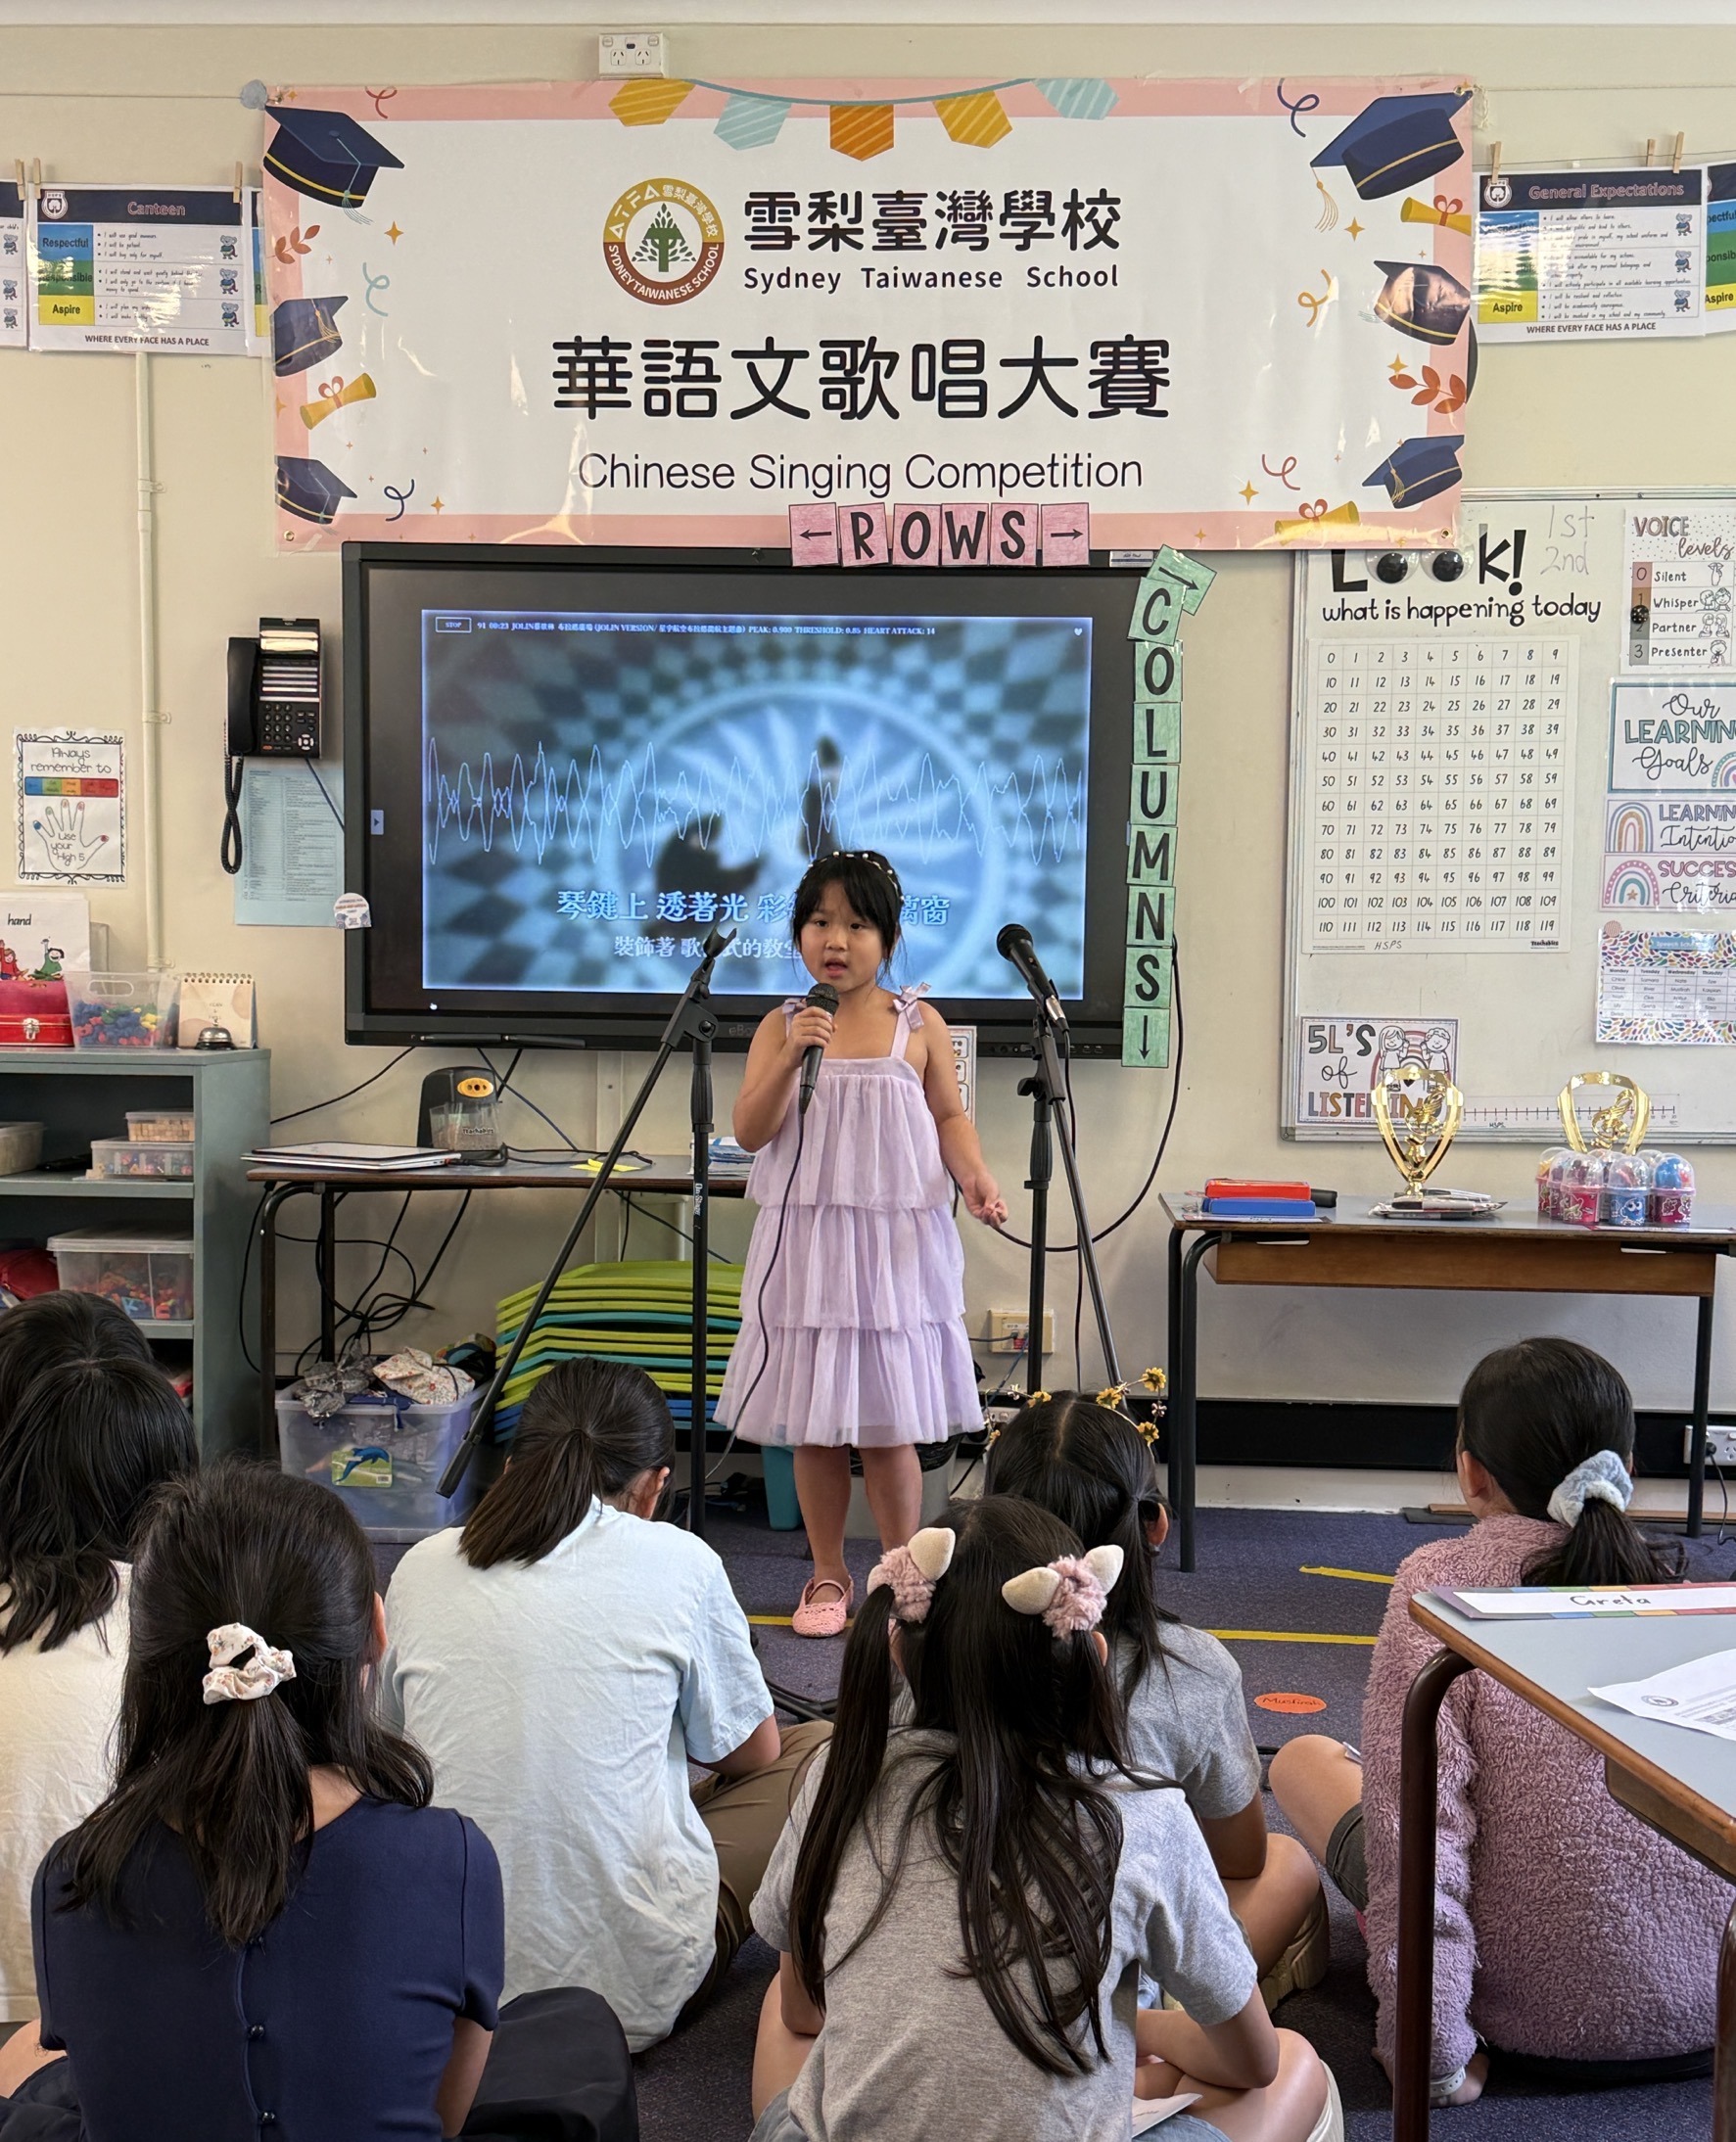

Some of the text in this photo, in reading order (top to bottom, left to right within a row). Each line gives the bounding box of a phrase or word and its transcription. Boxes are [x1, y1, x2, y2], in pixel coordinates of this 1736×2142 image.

[1528, 181, 1684, 201] General Expectations
[127, 201, 186, 216] Canteen
[662, 184, 720, 238] 雪梨臺灣學校
[744, 188, 1121, 253] 雪梨臺灣學校
[42, 237, 89, 249] Respectful
[608, 243, 720, 301] SYDNEY TAIWANESE SCHOOL
[744, 263, 1119, 295] Sydney Taiwanese School
[1492, 302, 1524, 314] Aspire
[1705, 292, 1734, 306] Aspire
[52, 303, 81, 315] Aspire
[1526, 325, 1556, 334] WHERE
[1557, 324, 1583, 333] EVERY
[1584, 323, 1605, 332] FACE
[1605, 323, 1622, 332] HAS
[1631, 322, 1657, 331] PLACE
[114, 335, 138, 344] EVERY
[185, 337, 210, 346] PLACE
[552, 334, 1171, 420] 華語文歌唱大賽
[579, 452, 1143, 499] Chinese Singing Competition
[1633, 515, 1690, 537] VOICE
[850, 510, 1026, 561] ROWS
[1540, 540, 1589, 575] 2nd
[1677, 536, 1734, 561] levels
[1636, 567, 1687, 582] 0 Silent
[1322, 592, 1602, 627] what is happening today
[1653, 597, 1699, 611] Whisper
[1652, 622, 1697, 633] Partner
[1327, 648, 1559, 664] 0 1 2 3 4 5 6 7 8 9
[1634, 644, 1708, 659] 3 Presenter
[1326, 673, 1561, 689] 10 11 12 13 14 15 16 17 18 19
[1323, 698, 1511, 714] 20 21 22 23 24 25 26 27
[1662, 693, 1721, 720] Our
[1624, 719, 1736, 744] LEARNIN
[51, 746, 91, 766] Always
[1631, 746, 1713, 781] Goals
[30, 764, 113, 774] remember to
[1132, 586, 1175, 1003] COLUMNS
[1659, 803, 1736, 822] LEARNIN
[58, 832, 76, 841] Use
[50, 842, 72, 856] your
[57, 853, 85, 867] High 5
[1657, 860, 1736, 878] SUCCES
[556, 890, 649, 921] 琴鍵上
[655, 891, 750, 923] 透著光
[7, 913, 32, 926] hand
[613, 935, 676, 958] 裝飾著
[1374, 940, 1402, 951] HSPS
[728, 1026, 752, 1038] eBo
[1308, 1023, 1377, 1057] 5L'S
[1321, 1055, 1358, 1089] of
[1308, 1091, 1442, 1119] LISTEIN
[1569, 1594, 1652, 1606] Greta
